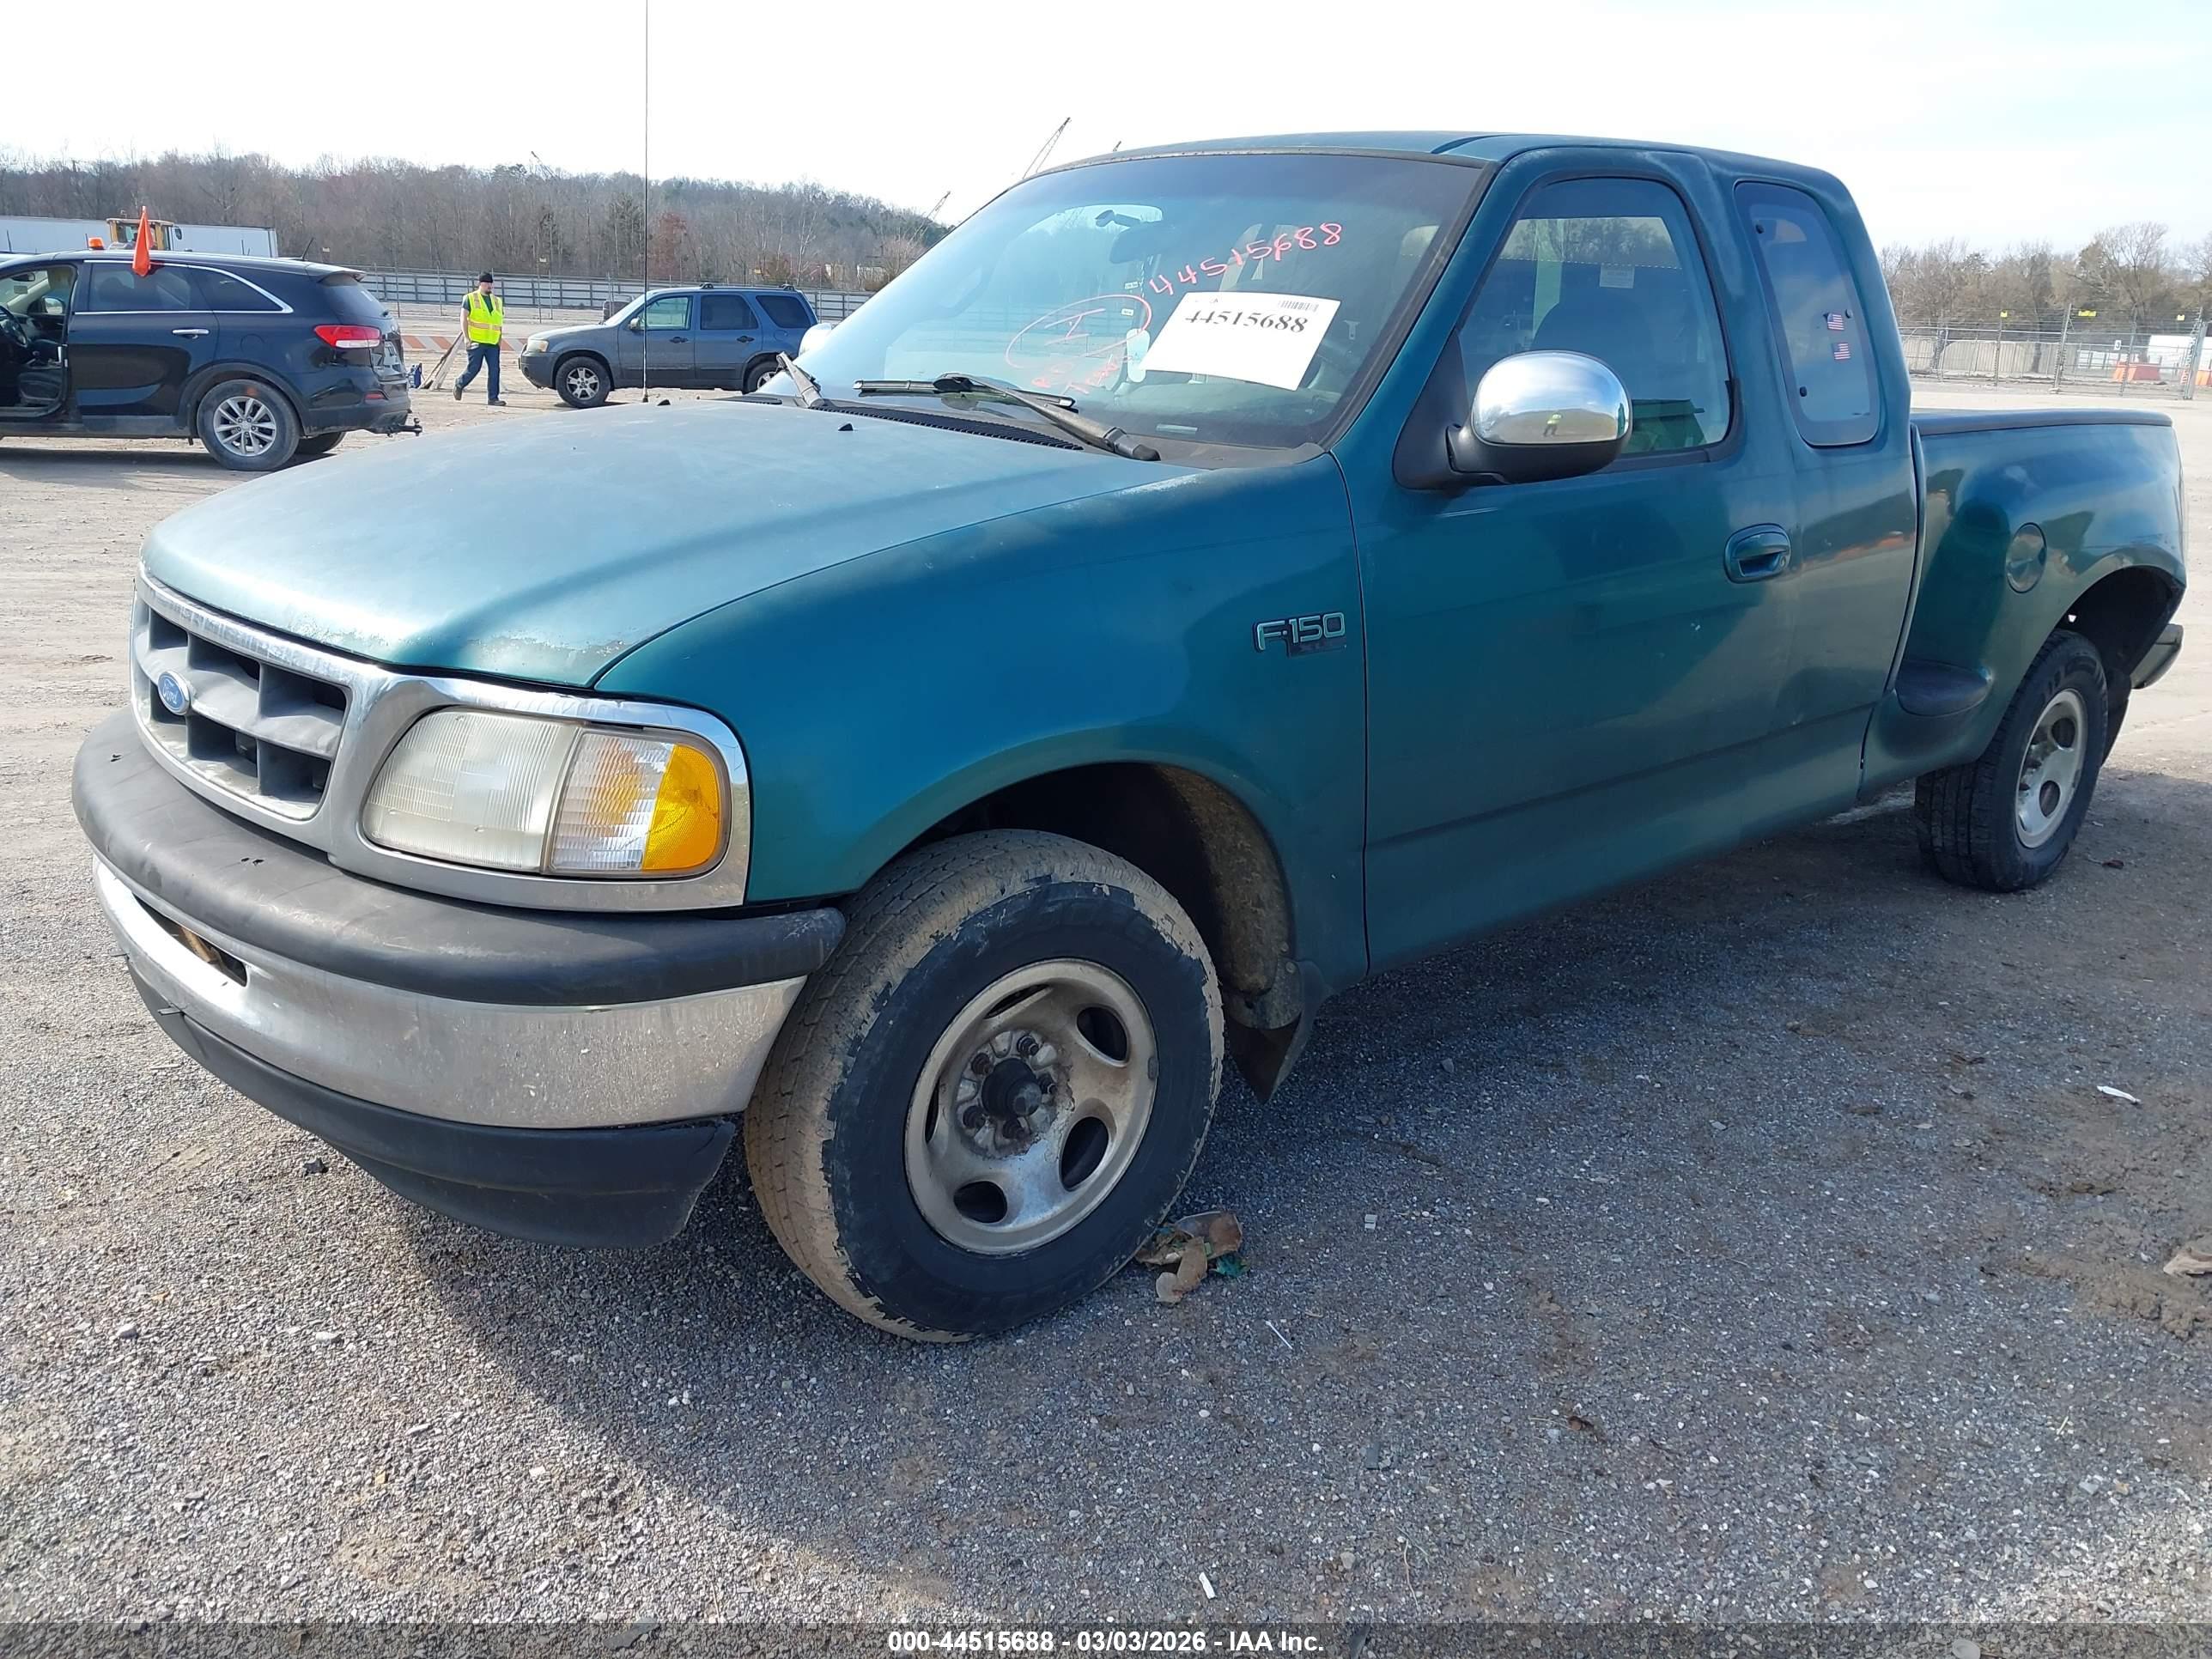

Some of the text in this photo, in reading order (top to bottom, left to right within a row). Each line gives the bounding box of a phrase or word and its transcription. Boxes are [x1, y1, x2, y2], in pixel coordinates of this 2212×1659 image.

[1149, 222, 1343, 295] 44515688
[1185, 310, 1310, 333] 44515688
[1256, 611, 1346, 651] F-150
